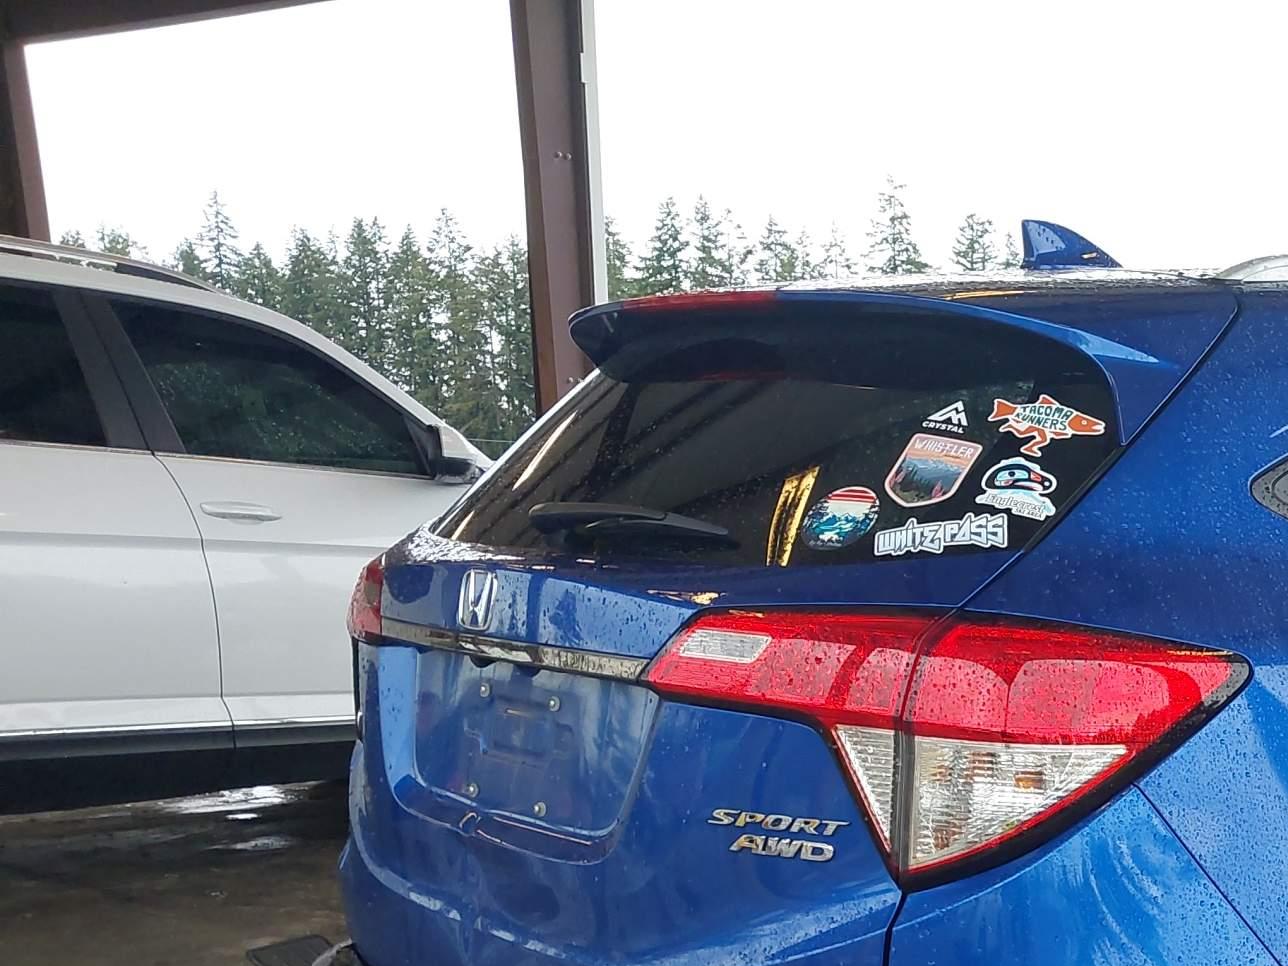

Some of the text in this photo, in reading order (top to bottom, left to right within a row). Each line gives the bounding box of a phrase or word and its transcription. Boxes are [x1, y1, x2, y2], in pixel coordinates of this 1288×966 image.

[1015, 411, 1067, 431] RUNNERS
[1020, 405, 1073, 421] TACOMA
[921, 420, 965, 434] CRYSTAL
[914, 438, 975, 459] WHISTLER
[877, 514, 1004, 553] WHITE PASS
[707, 808, 850, 836] SPORT
[728, 834, 835, 862] AWD
